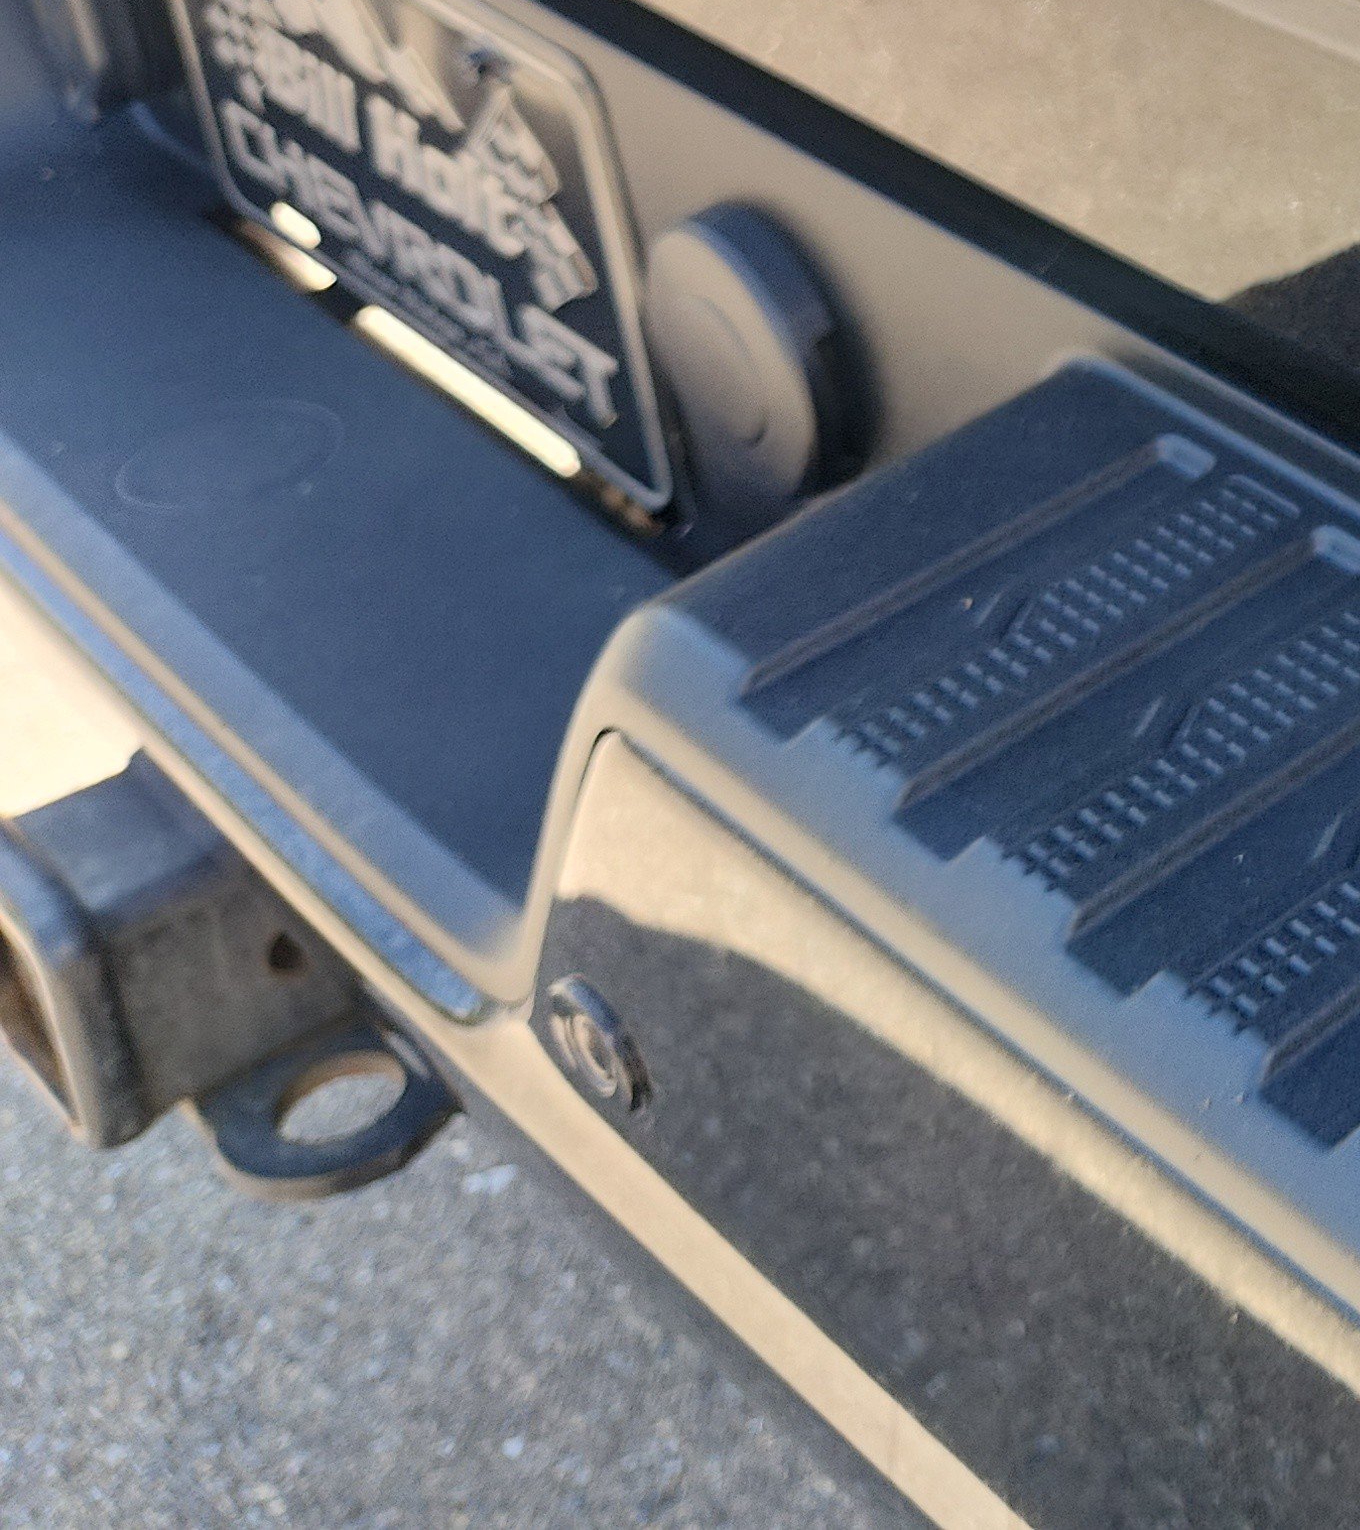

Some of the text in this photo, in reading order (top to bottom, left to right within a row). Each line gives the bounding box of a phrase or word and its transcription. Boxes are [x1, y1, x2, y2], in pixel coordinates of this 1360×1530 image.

[217, 99, 618, 429] CHEVROLET
[250, 22, 527, 258] Bill Holt
